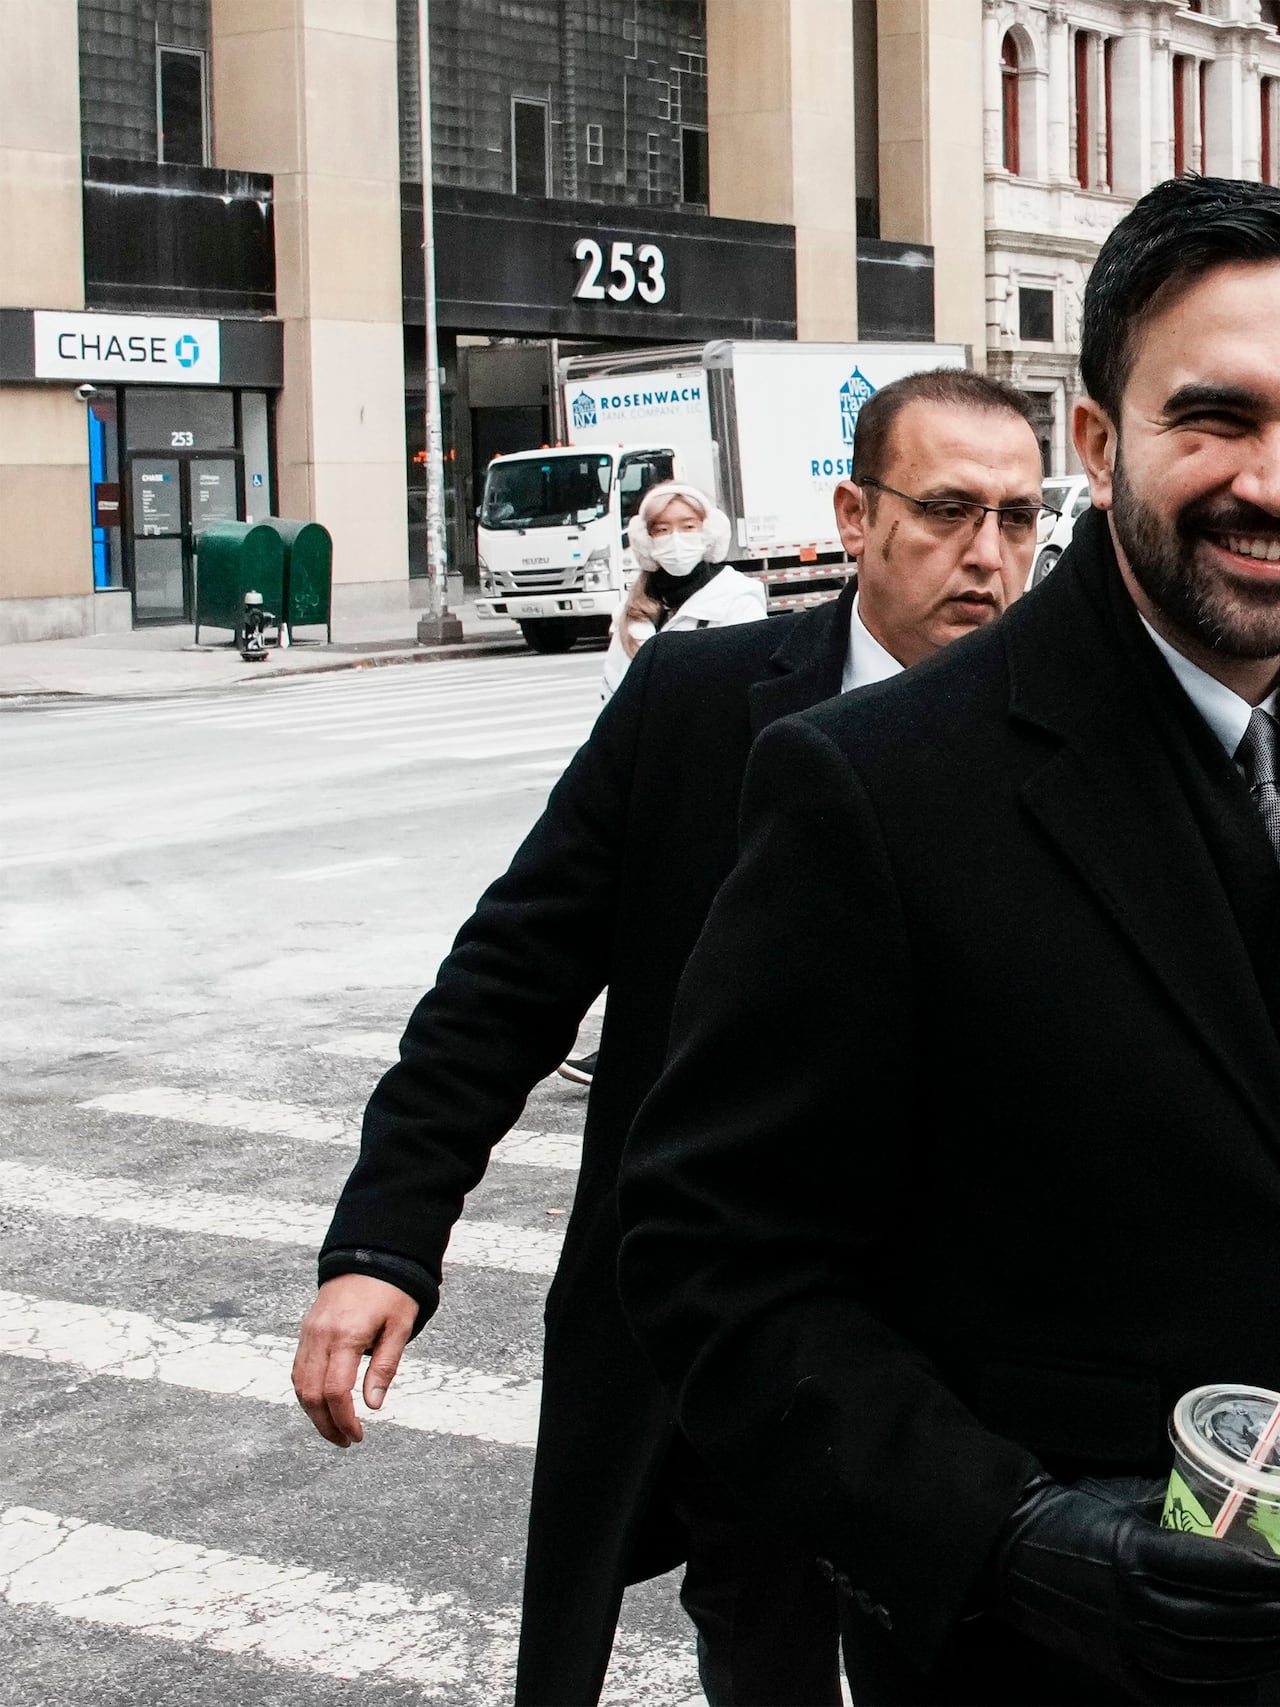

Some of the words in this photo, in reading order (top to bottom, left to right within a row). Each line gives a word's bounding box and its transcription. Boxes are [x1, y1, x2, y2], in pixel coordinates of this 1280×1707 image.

[572, 238, 666, 304] 253
[58, 333, 168, 363] CHASE
[601, 387, 701, 410] ROSENWACH
[170, 431, 194, 447] 253
